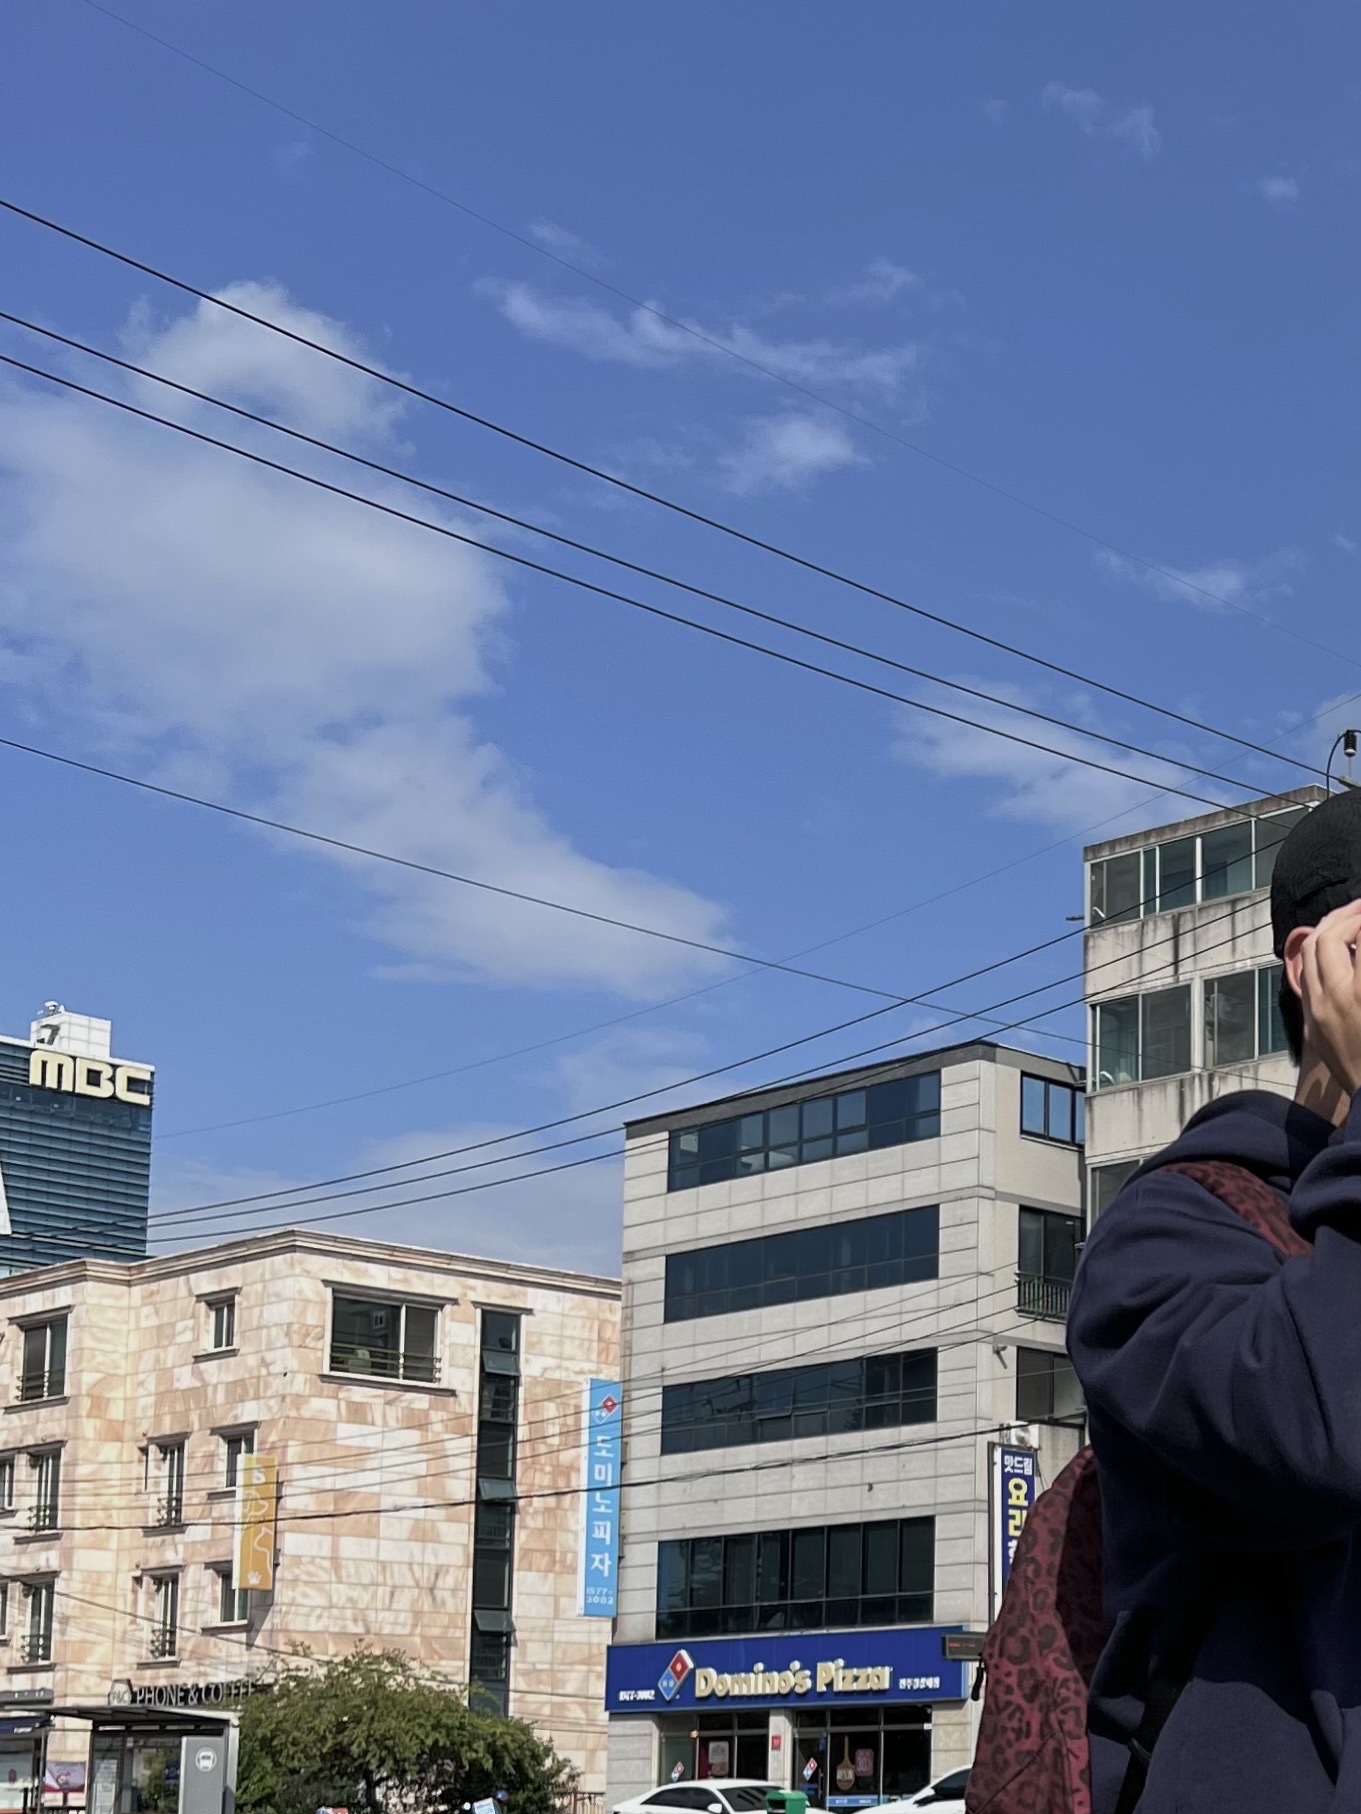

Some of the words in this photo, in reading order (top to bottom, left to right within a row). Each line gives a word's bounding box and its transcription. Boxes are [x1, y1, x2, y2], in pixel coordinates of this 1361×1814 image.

[29, 1049, 151, 1106] MBC
[590, 1435, 615, 1578] 도미노피자
[136, 1684, 186, 1706] PHONE
[188, 1685, 199, 1706] &
[695, 1660, 812, 1698] Domino's
[816, 1658, 891, 1692] Pizza
